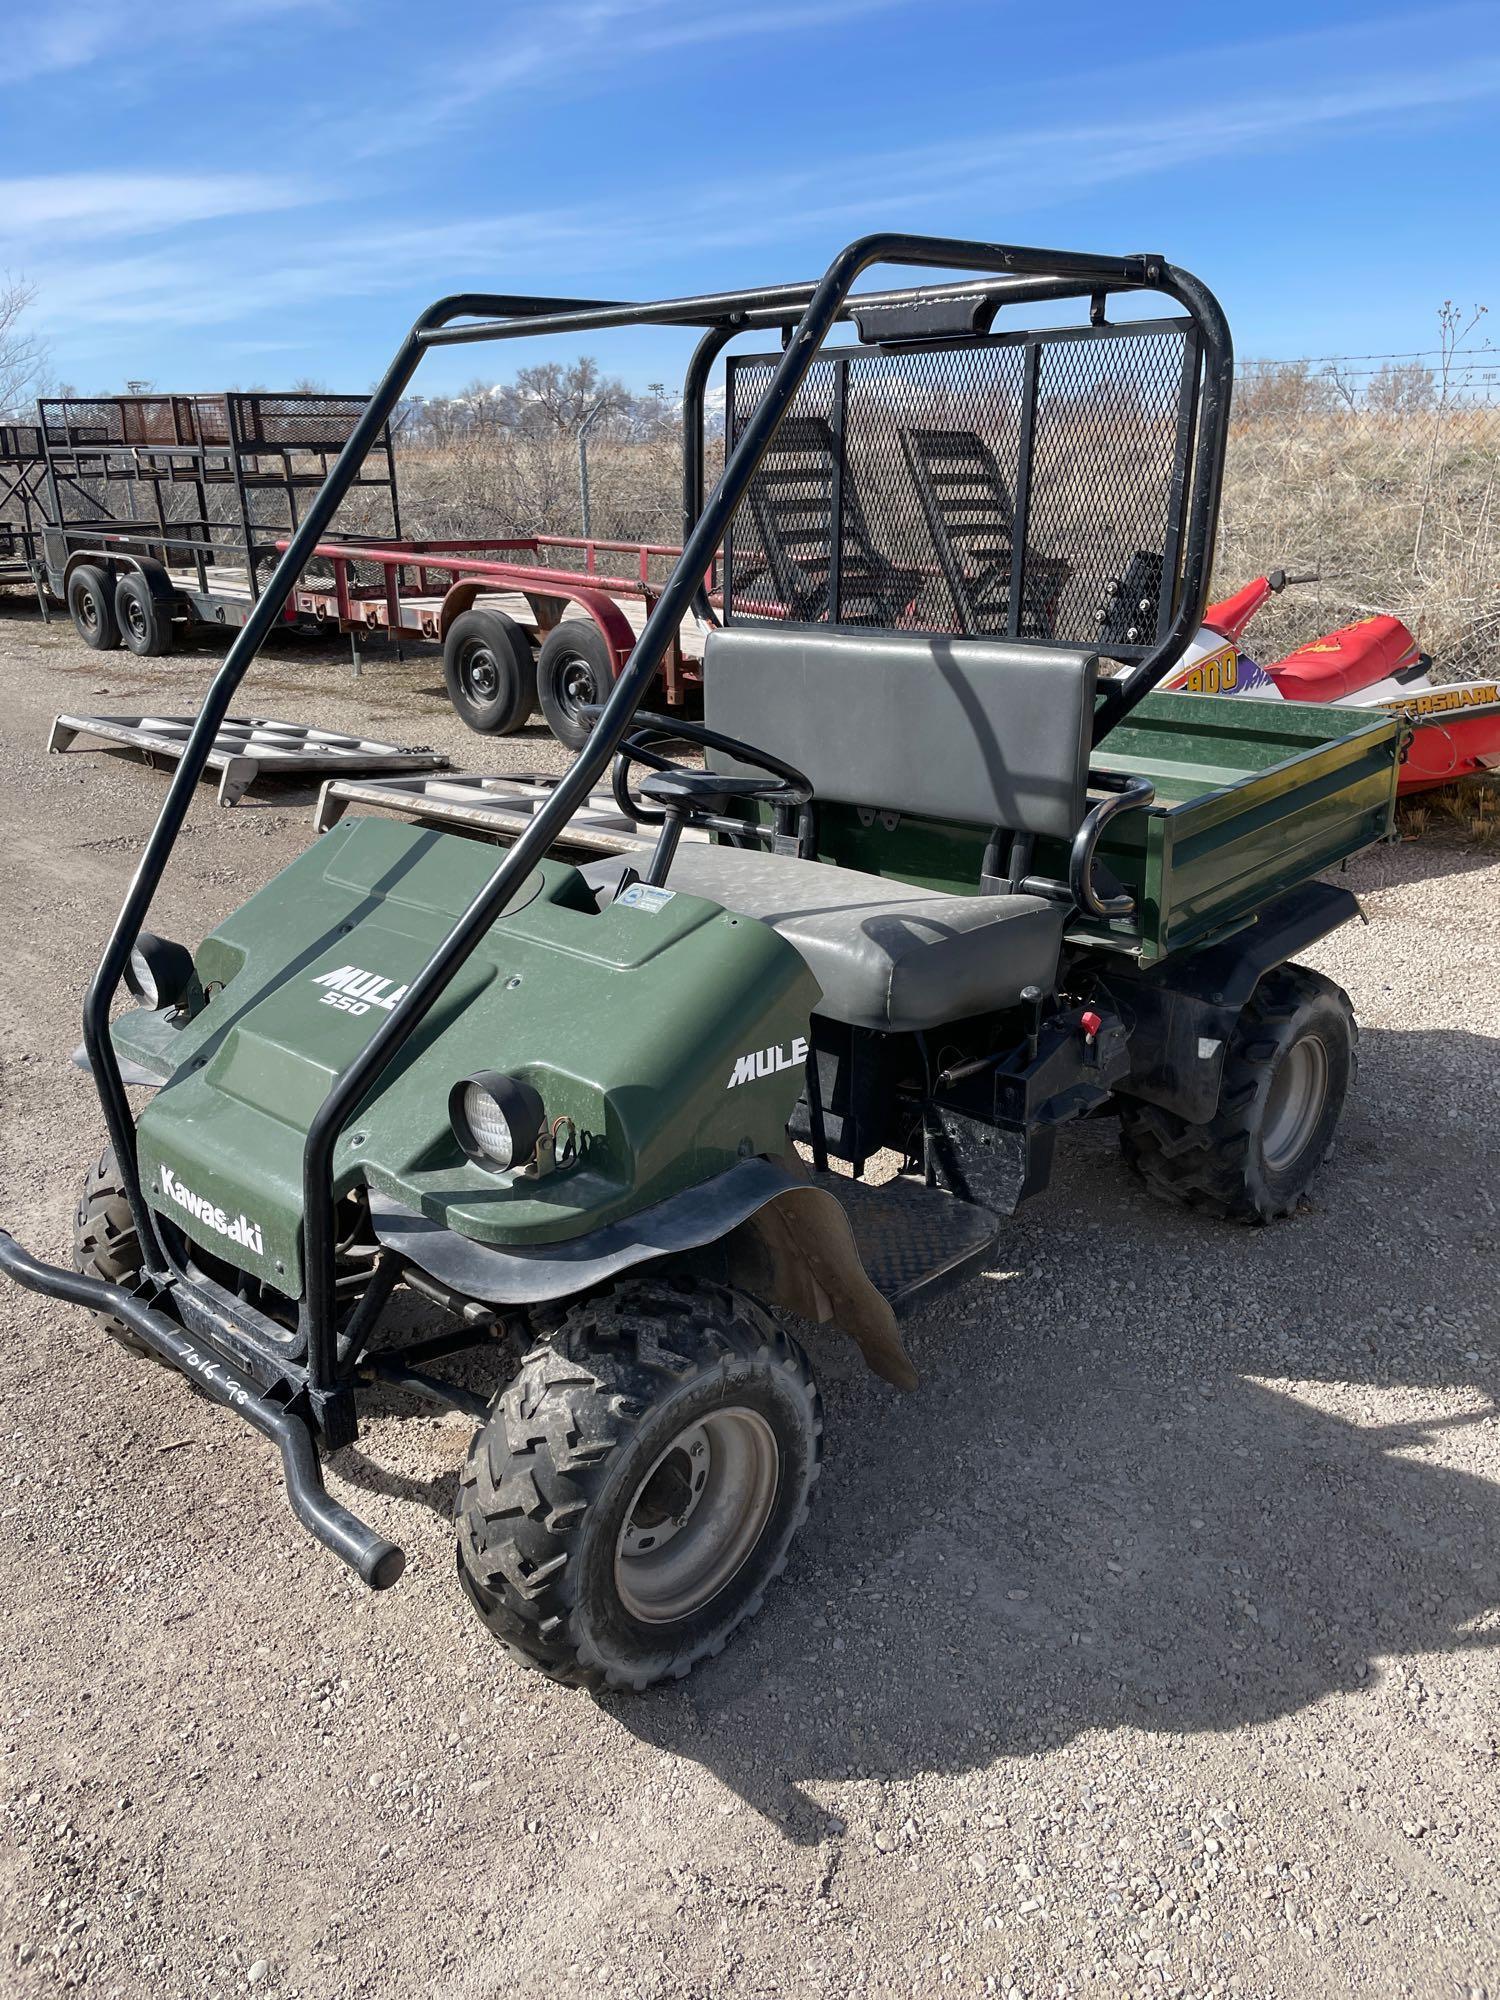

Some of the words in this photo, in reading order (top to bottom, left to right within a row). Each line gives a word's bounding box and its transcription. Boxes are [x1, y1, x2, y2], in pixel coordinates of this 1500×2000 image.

[1187, 650, 1238, 693] 900
[1376, 685, 1500, 716] GERSHARK
[319, 991, 371, 1016] 550
[726, 1036, 809, 1090] MULE
[160, 1164, 264, 1256] Kawasaki
